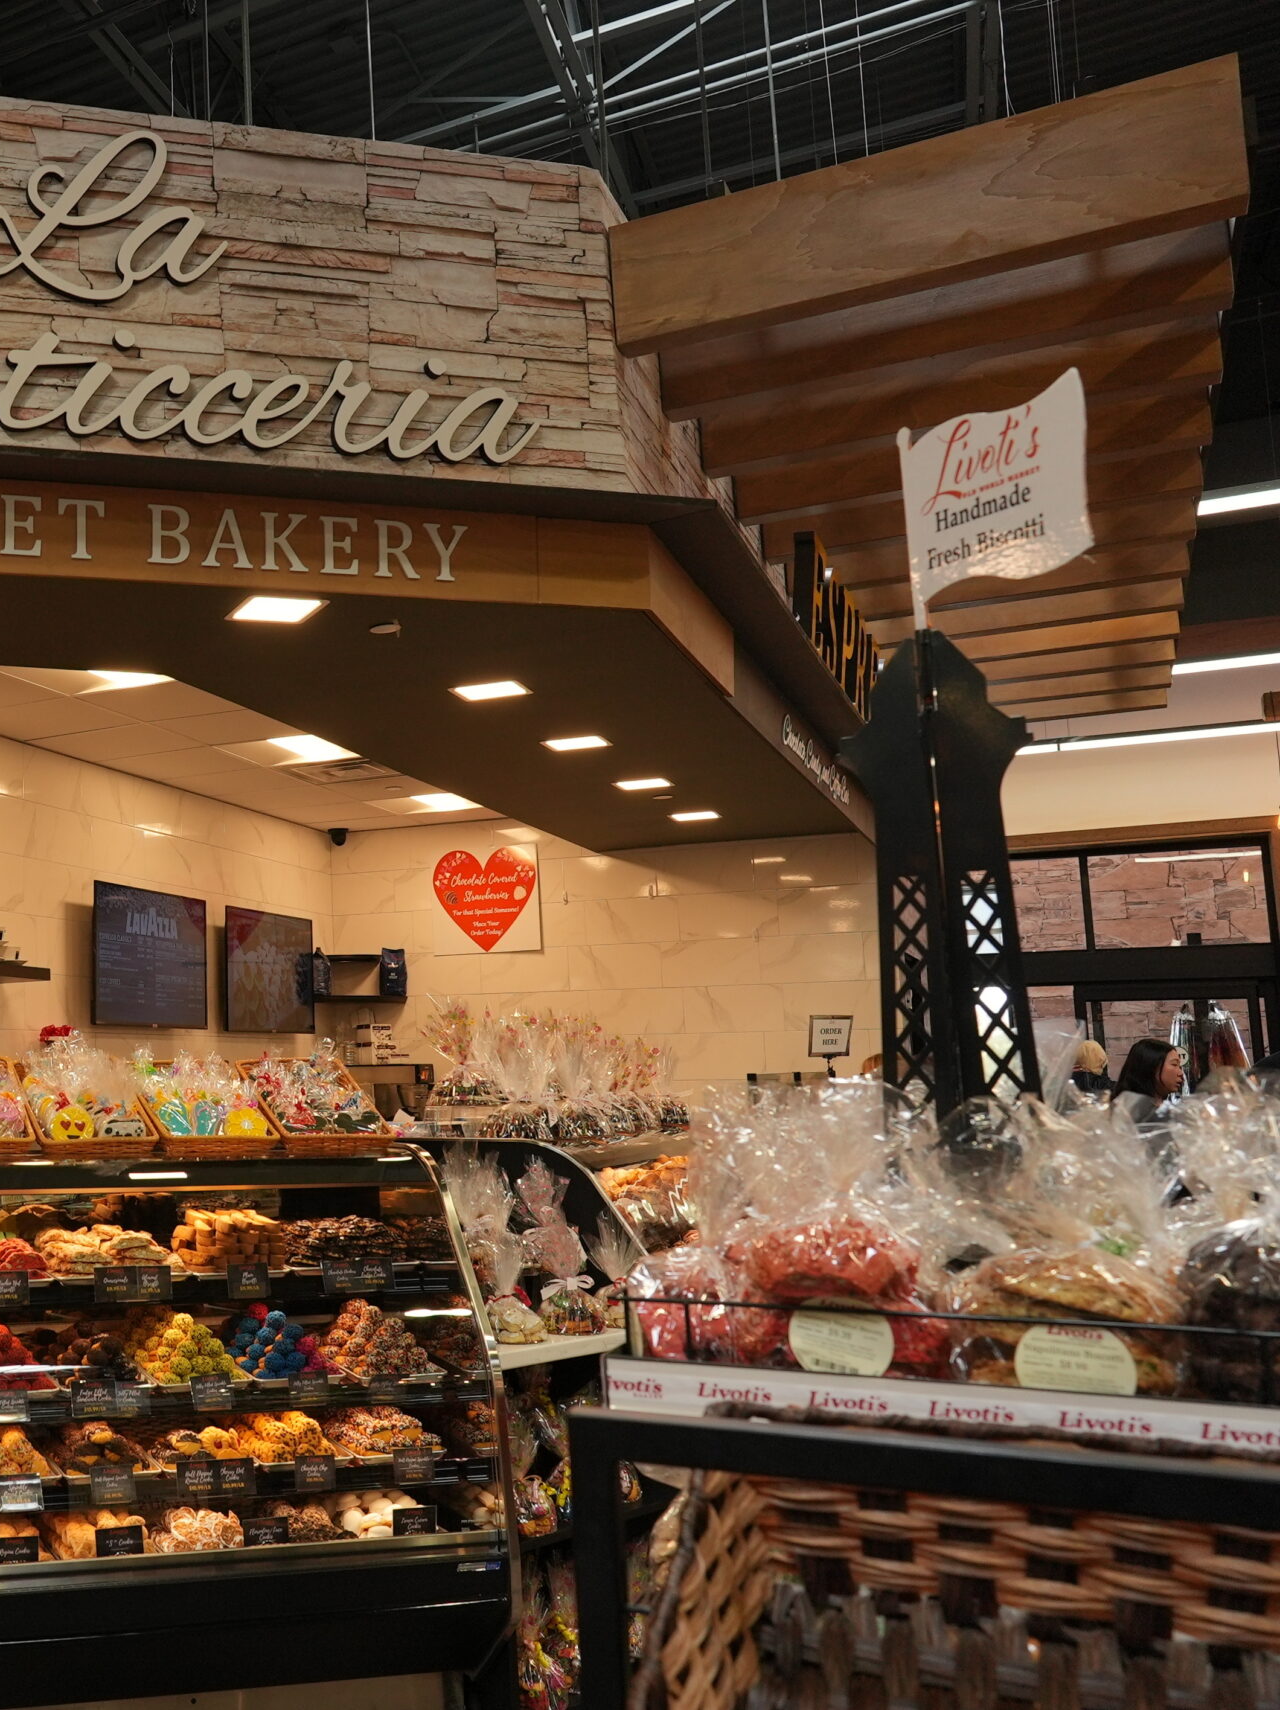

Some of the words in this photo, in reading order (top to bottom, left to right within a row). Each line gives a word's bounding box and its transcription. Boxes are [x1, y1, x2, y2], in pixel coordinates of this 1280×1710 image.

[921, 404, 1040, 516] Livoti's
[979, 478, 1004, 493] WORLD
[1007, 466, 1040, 482] MARKET
[934, 483, 1032, 533] Handmade
[146, 503, 469, 582] BAKERY
[927, 538, 972, 570] Fresh
[976, 514, 1046, 554] Biscotti
[451, 872, 487, 888] Chocolate
[488, 872, 518, 884] Covered
[464, 888, 510, 902] Strawberries
[125, 907, 178, 940] LAVAZZA
[822, 1038, 838, 1046] HERE
[608, 1376, 662, 1394] ivoti's
[696, 1381, 773, 1404] Livoti's
[808, 1390, 890, 1413] Livoti's
[928, 1400, 1015, 1424] Livoti's
[1058, 1410, 1154, 1435] Livoti's
